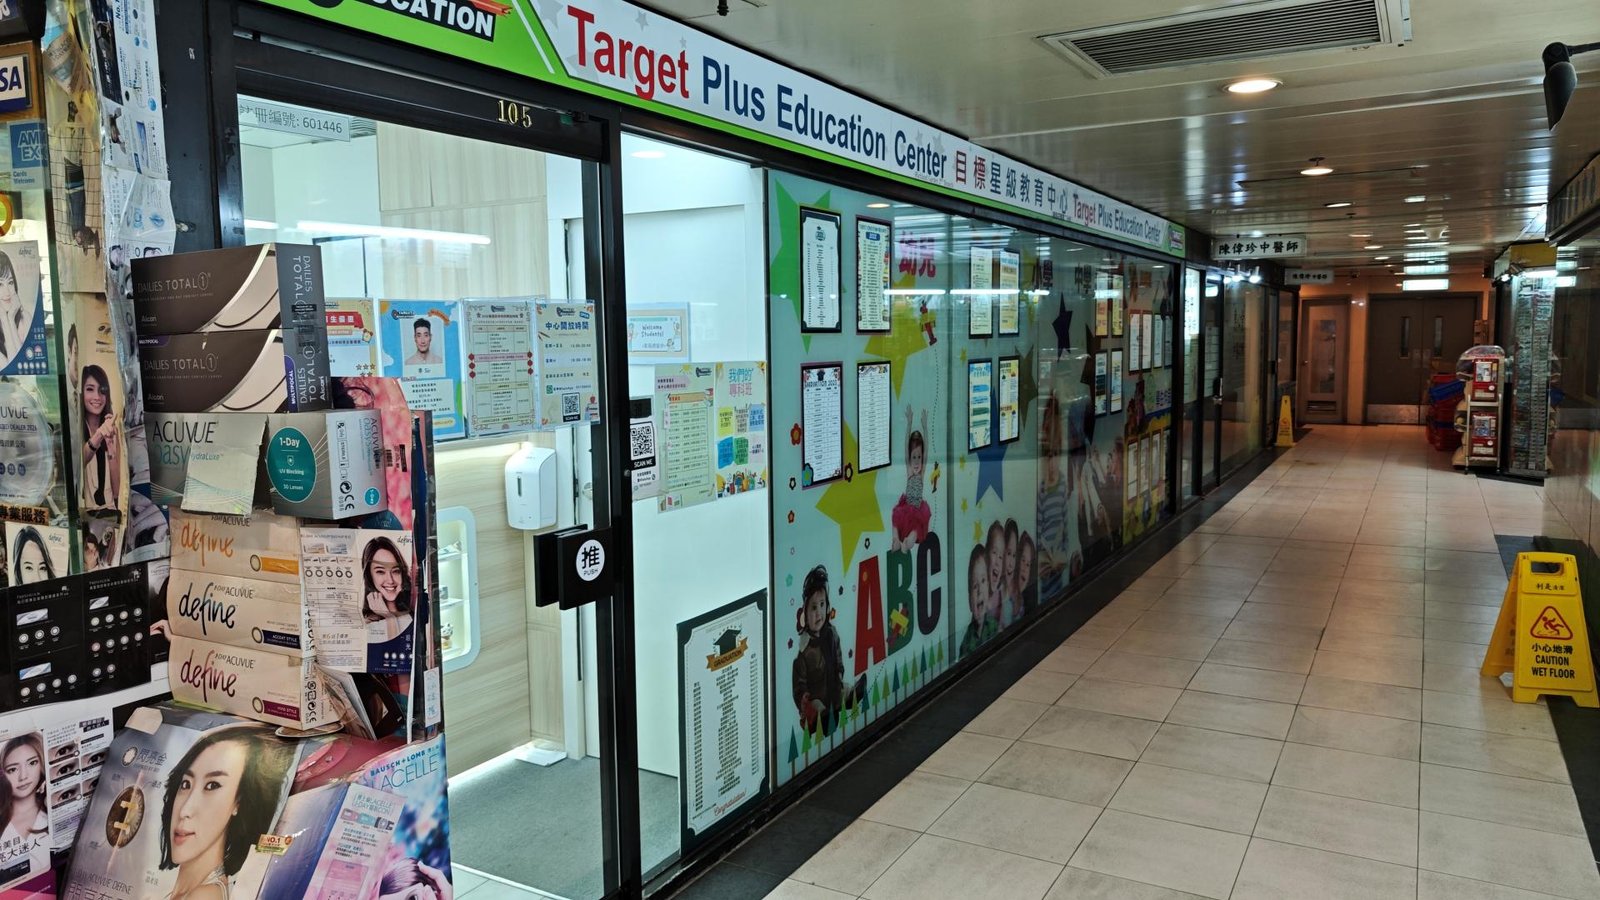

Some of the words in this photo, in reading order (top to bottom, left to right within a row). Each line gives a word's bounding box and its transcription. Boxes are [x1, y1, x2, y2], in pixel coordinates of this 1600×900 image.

[372, 0, 494, 37] CATION
[568, 6, 689, 100] Target
[703, 55, 766, 122] Plus
[777, 83, 886, 162] Education
[894, 130, 947, 180] Center
[302, 116, 343, 133] 601446
[497, 99, 533, 128] 105
[955, 150, 1068, 214] 目標星級教育中心
[1073, 193, 1096, 227] Target
[1098, 203, 1112, 229] Plus
[1114, 209, 1144, 237] Education
[1145, 220, 1161, 242] Center
[1218, 240, 1299, 255] 陳偉珍中醫師
[138, 280, 163, 292] DAILIES
[303, 256, 313, 293] DAILIES
[144, 360, 170, 370] DAILIES
[289, 370, 297, 405] MULTIFOCAL
[298, 367, 307, 404] DAILIES
[152, 420, 216, 443] ACUVUE
[279, 437, 300, 448] 1-Day
[634, 460, 645, 468] SCAN
[0, 502, 46, 523] 專業服務
[223, 516, 250, 527] ACUVUE
[581, 546, 600, 569] 推
[225, 586, 254, 599] ACUVUE
[854, 531, 942, 677] ABC
[179, 582, 236, 636] define
[1531, 643, 1573, 655] 小心地滑
[1535, 655, 1569, 666] CAUTION
[226, 655, 254, 669] ACUVUE
[1531, 667, 1547, 677] WET
[1549, 668, 1575, 679] FLOOR
[181, 650, 237, 704] define
[370, 761, 400, 777] BAUSCH
[407, 750, 426, 762] LOMB
